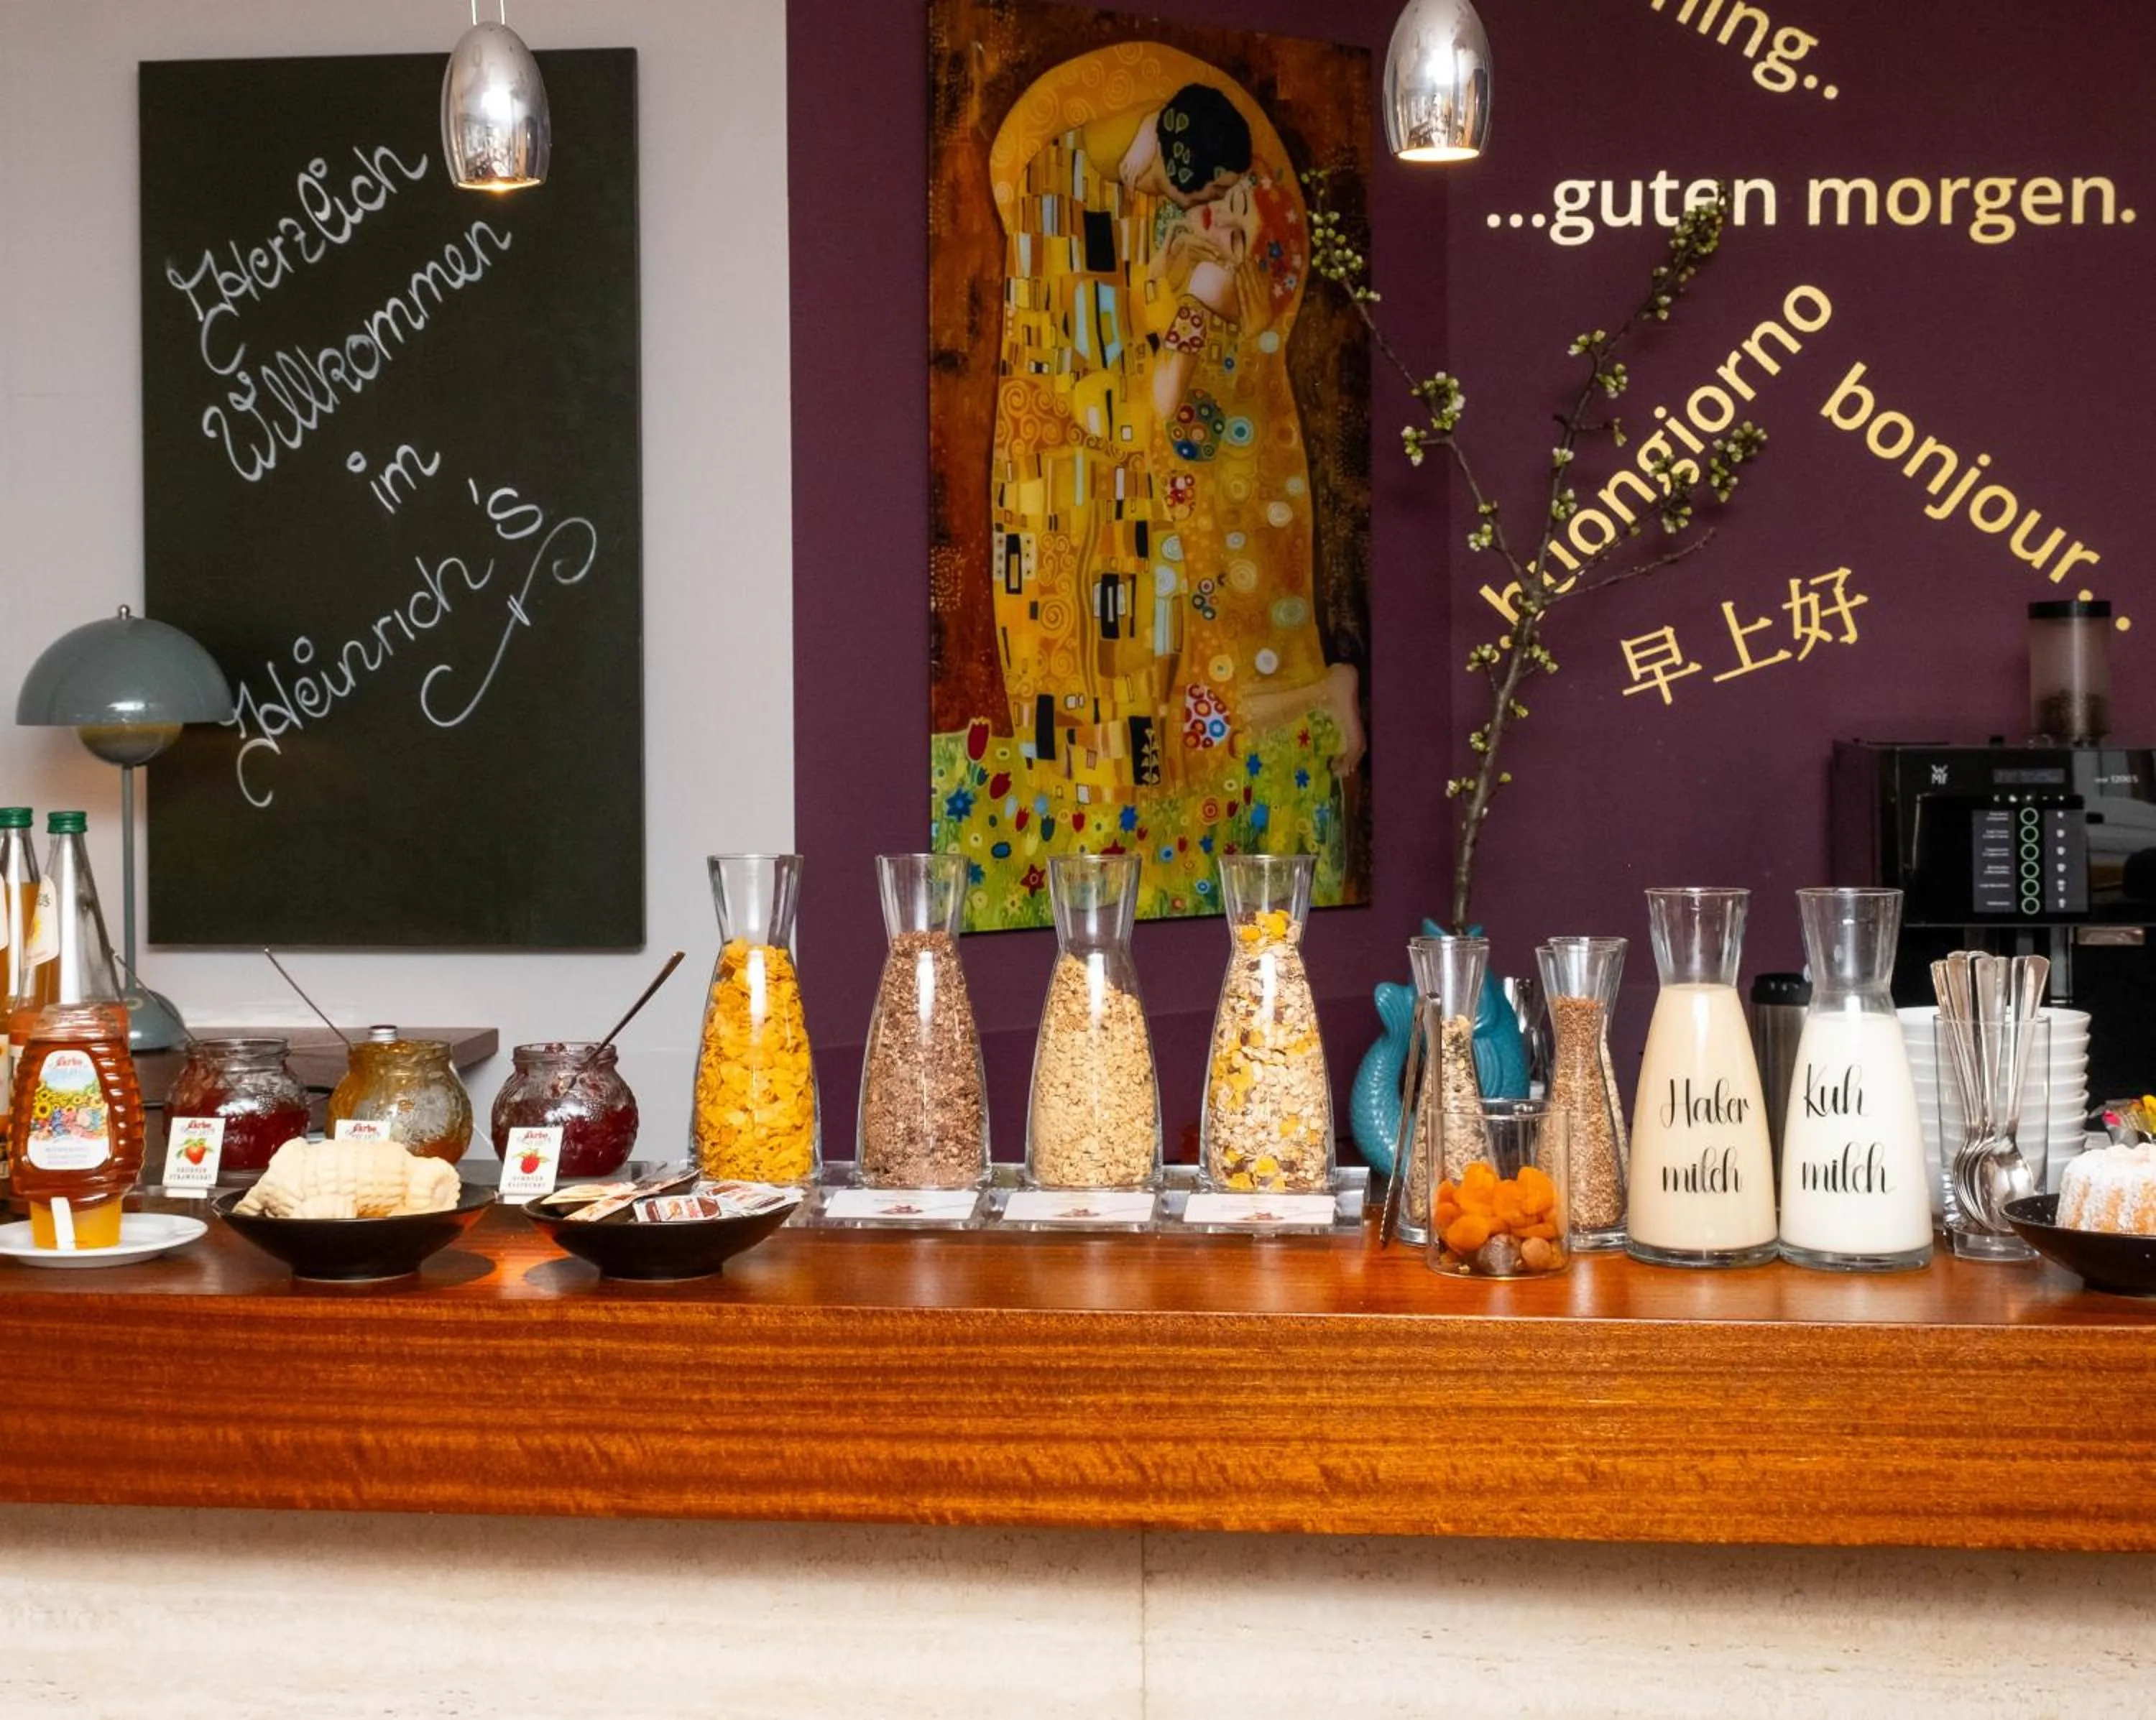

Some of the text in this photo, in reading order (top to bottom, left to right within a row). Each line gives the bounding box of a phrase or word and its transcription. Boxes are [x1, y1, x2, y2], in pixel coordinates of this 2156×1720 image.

[1807, 177, 2136, 244] morgen.
[167, 146, 428, 376] Herzlich
[203, 221, 512, 481] Willkommen
[346, 444, 441, 514] im
[1621, 566, 1869, 706] 早上好
[1804, 1063, 1871, 1118] Kuh
[1662, 1147, 1742, 1193] milch
[1802, 1141, 1896, 1194] milch
